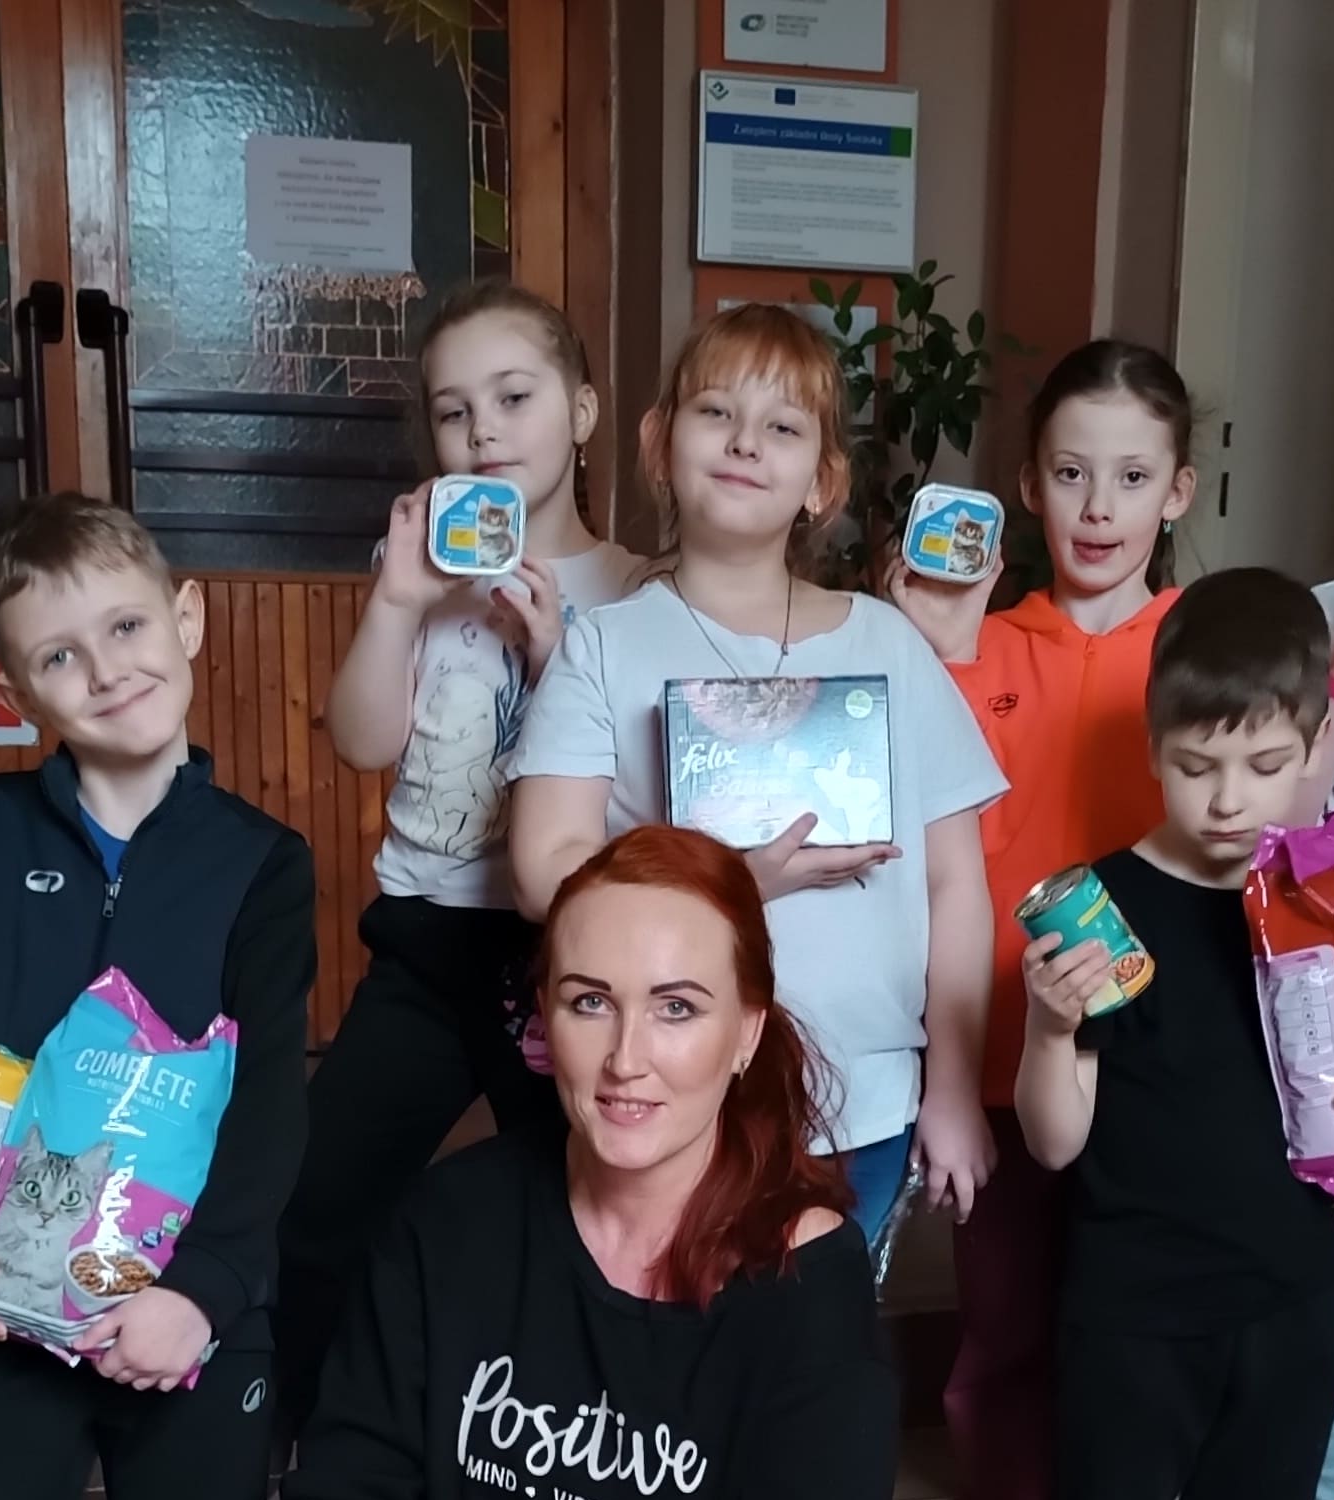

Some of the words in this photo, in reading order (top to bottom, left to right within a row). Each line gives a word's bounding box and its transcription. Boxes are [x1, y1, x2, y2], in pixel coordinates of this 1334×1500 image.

[677, 741, 740, 784] felix
[457, 1355, 707, 1496] Positive
[466, 1454, 517, 1492] MIND
